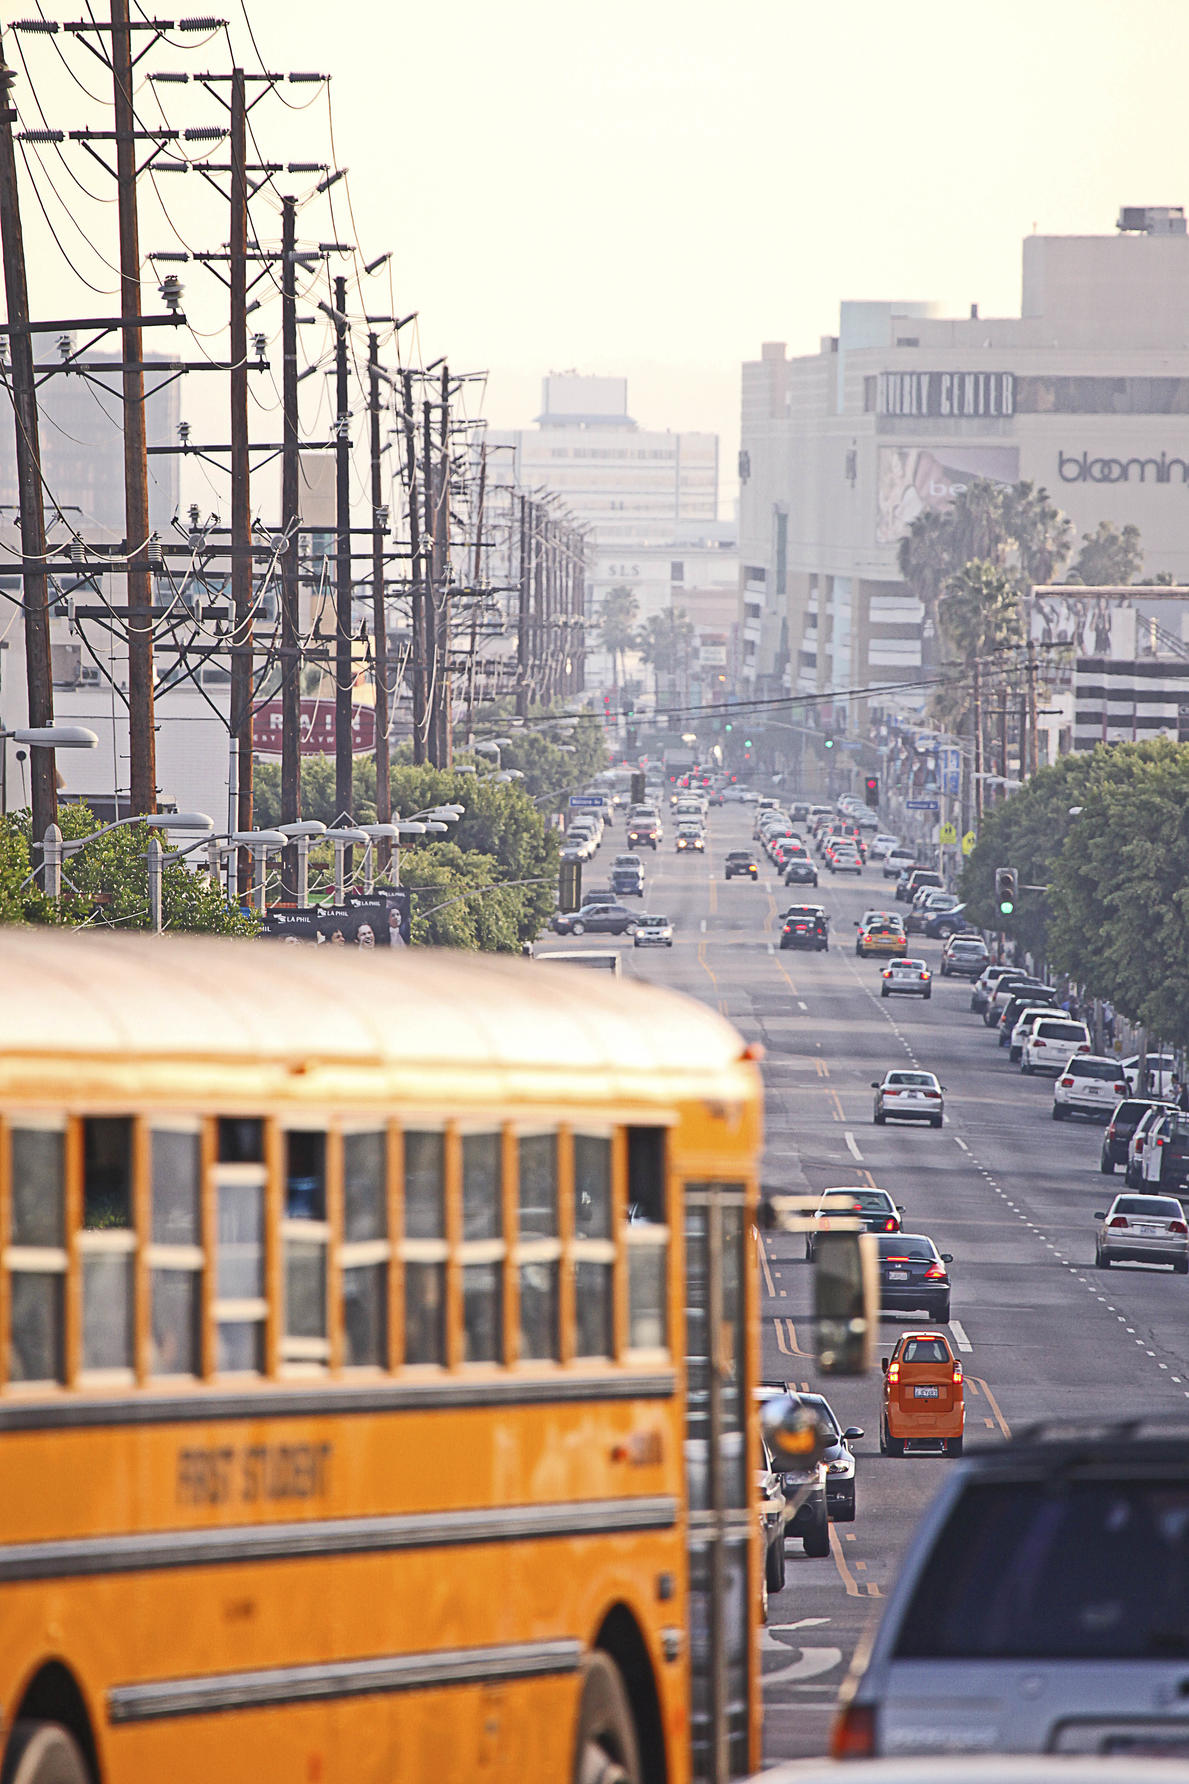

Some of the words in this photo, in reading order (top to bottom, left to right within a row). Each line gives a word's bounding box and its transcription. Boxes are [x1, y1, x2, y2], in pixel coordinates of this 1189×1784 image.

[940, 373, 1013, 415] CENTER
[1058, 450, 1189, 486] bloomin
[608, 564, 640, 577] SLS
